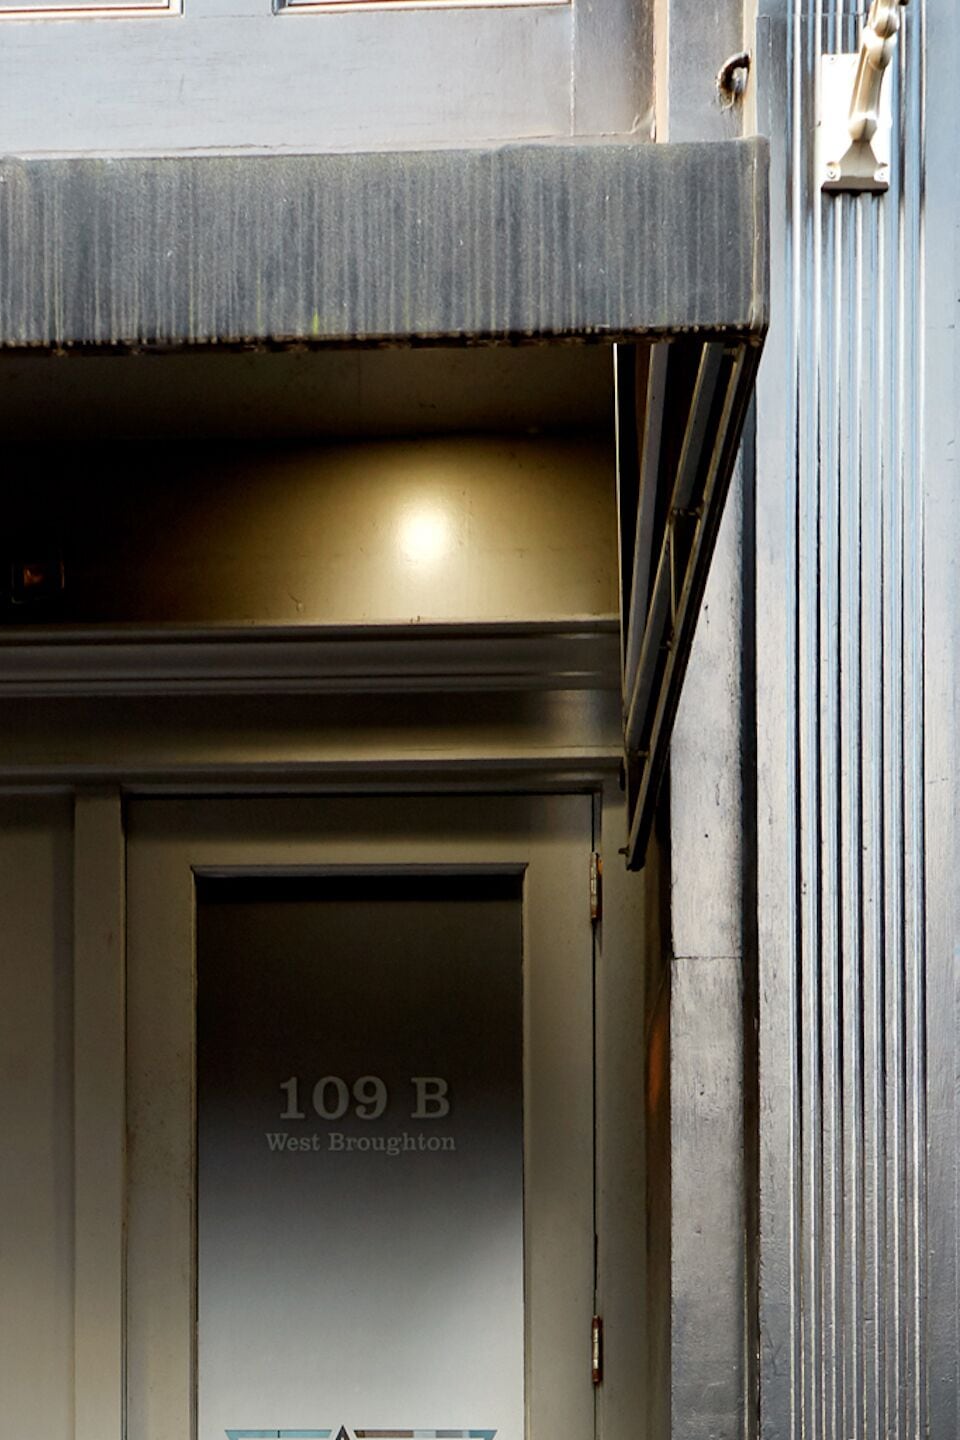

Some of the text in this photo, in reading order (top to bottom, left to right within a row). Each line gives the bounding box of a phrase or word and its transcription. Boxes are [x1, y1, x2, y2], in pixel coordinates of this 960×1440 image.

[280, 1076, 450, 1120] 109 B
[265, 1133, 456, 1155] West Broughton
